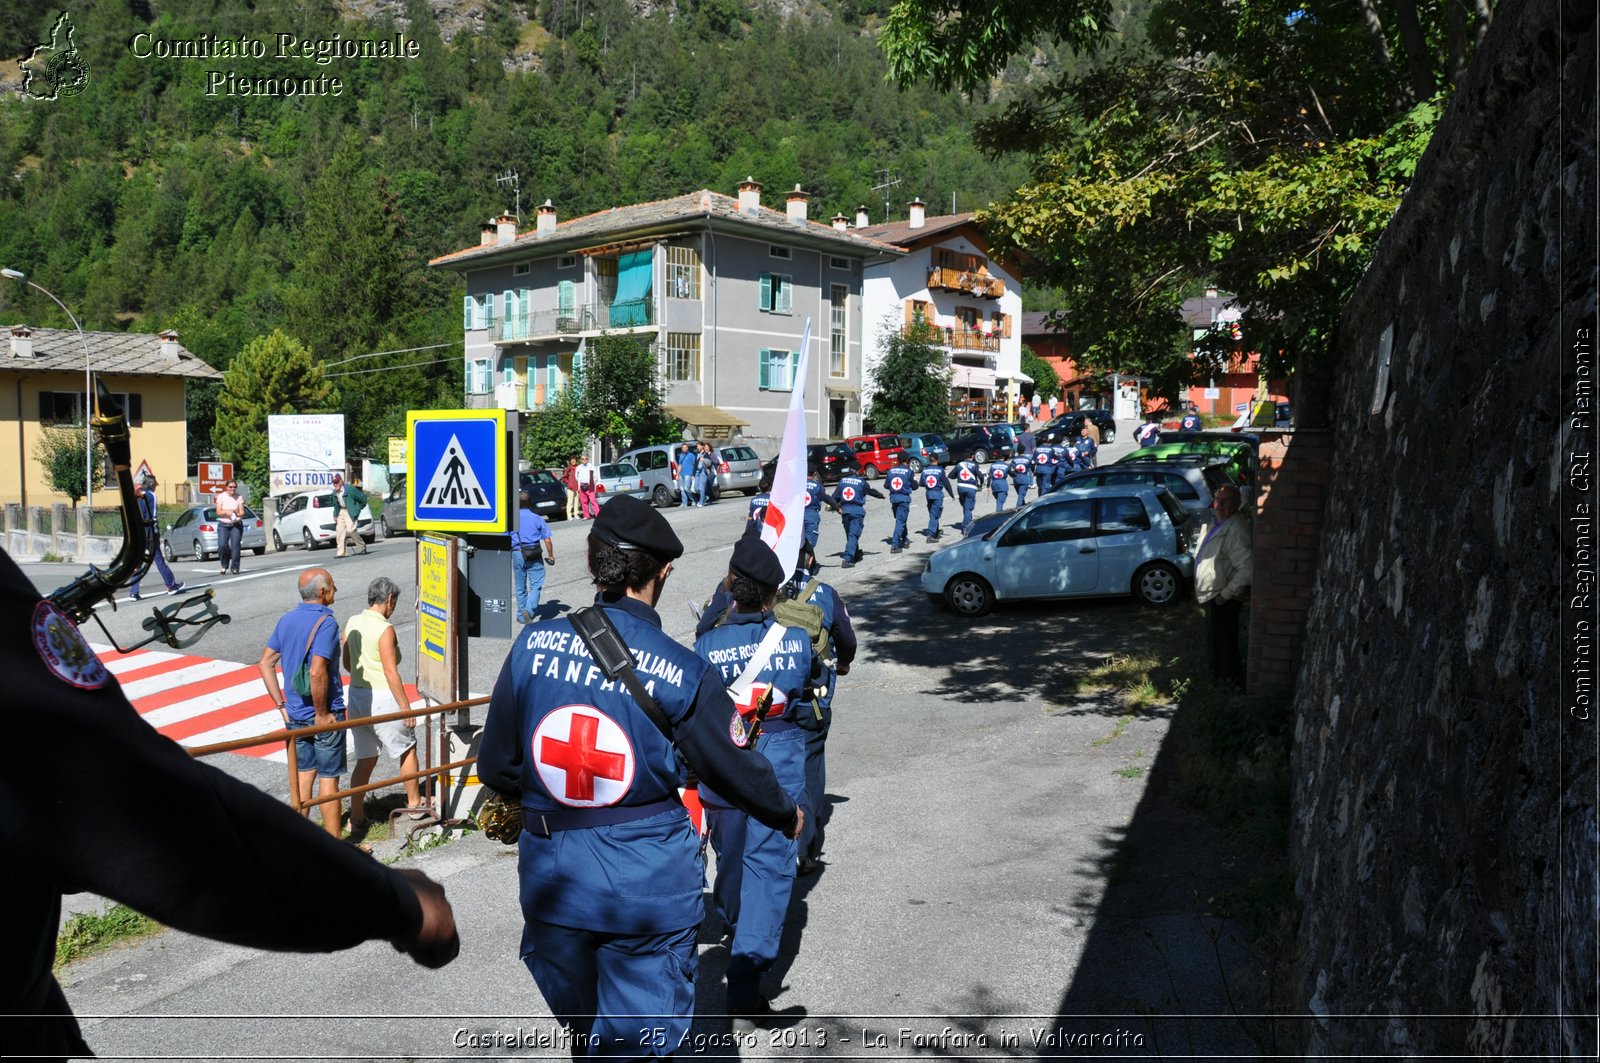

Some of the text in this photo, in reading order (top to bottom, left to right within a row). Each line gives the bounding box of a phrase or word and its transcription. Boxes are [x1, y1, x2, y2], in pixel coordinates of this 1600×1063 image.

[285, 473, 335, 486] SCI FOND
[527, 630, 571, 653] CROCE
[628, 647, 684, 688] TALIANA
[708, 647, 739, 664] CROCE
[738, 642, 761, 660] ROSS
[531, 653, 656, 698] FANFAA
[721, 656, 797, 679] FAARA
